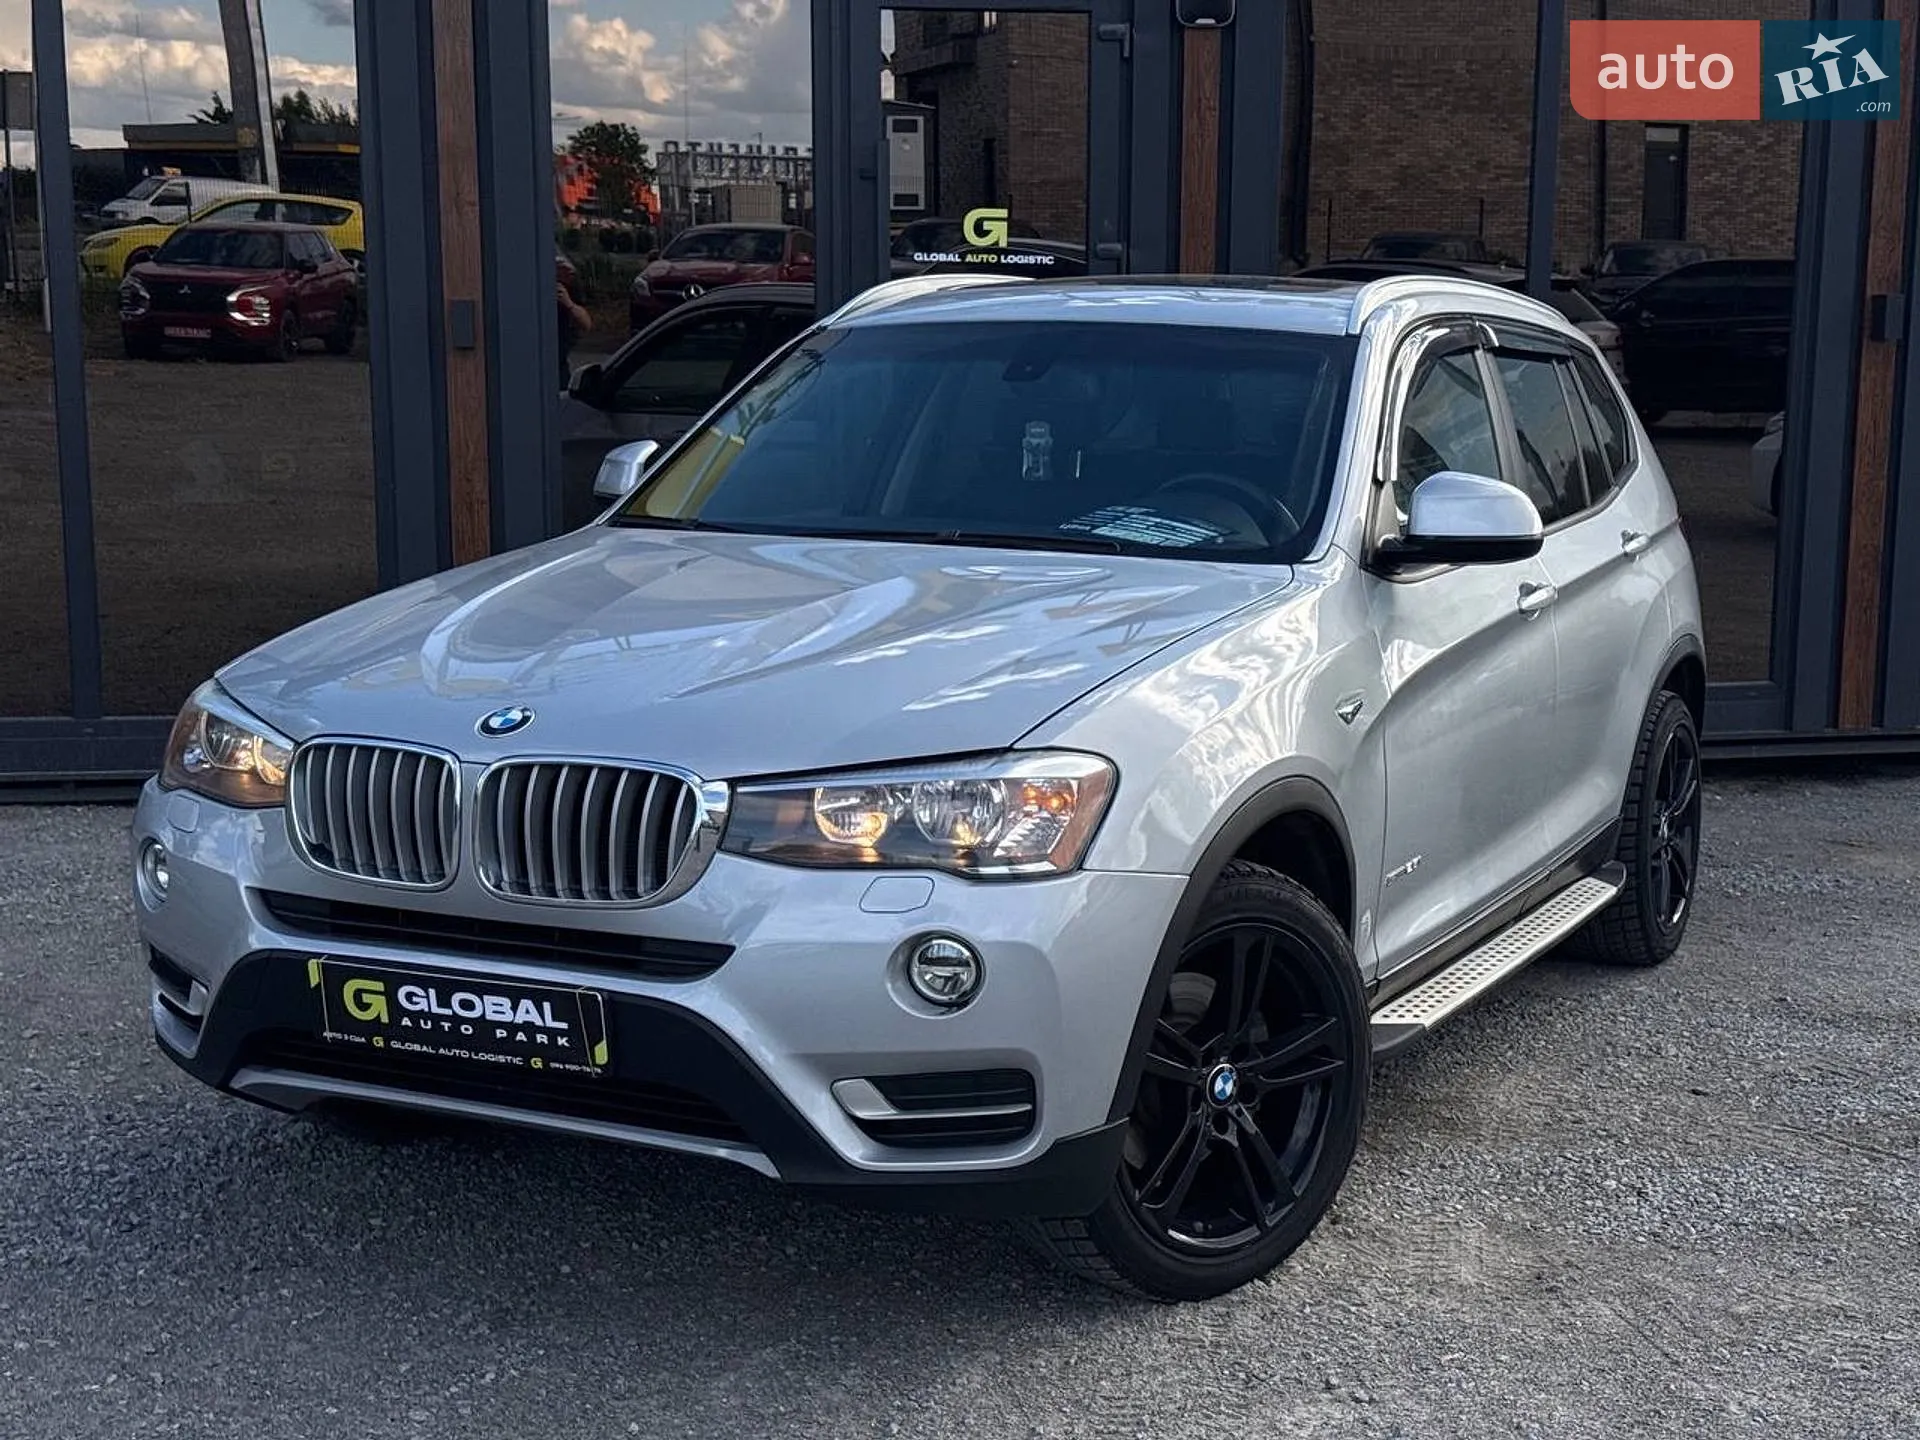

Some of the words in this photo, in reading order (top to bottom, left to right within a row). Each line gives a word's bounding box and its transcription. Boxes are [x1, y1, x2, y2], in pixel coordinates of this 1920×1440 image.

[963, 208, 1008, 248] G
[914, 252, 961, 262] GLOBAL
[965, 254, 998, 263] AUTO
[1001, 254, 1055, 265] LOGISTIC
[343, 978, 389, 1024] G
[397, 985, 568, 1029] GLOBAL
[401, 1016, 473, 1035] AUTO
[495, 1029, 570, 1047] PARK
[390, 1040, 435, 1054] GLOBAL
[438, 1047, 469, 1058] AUTO
[471, 1052, 523, 1065] LOGISTIC
